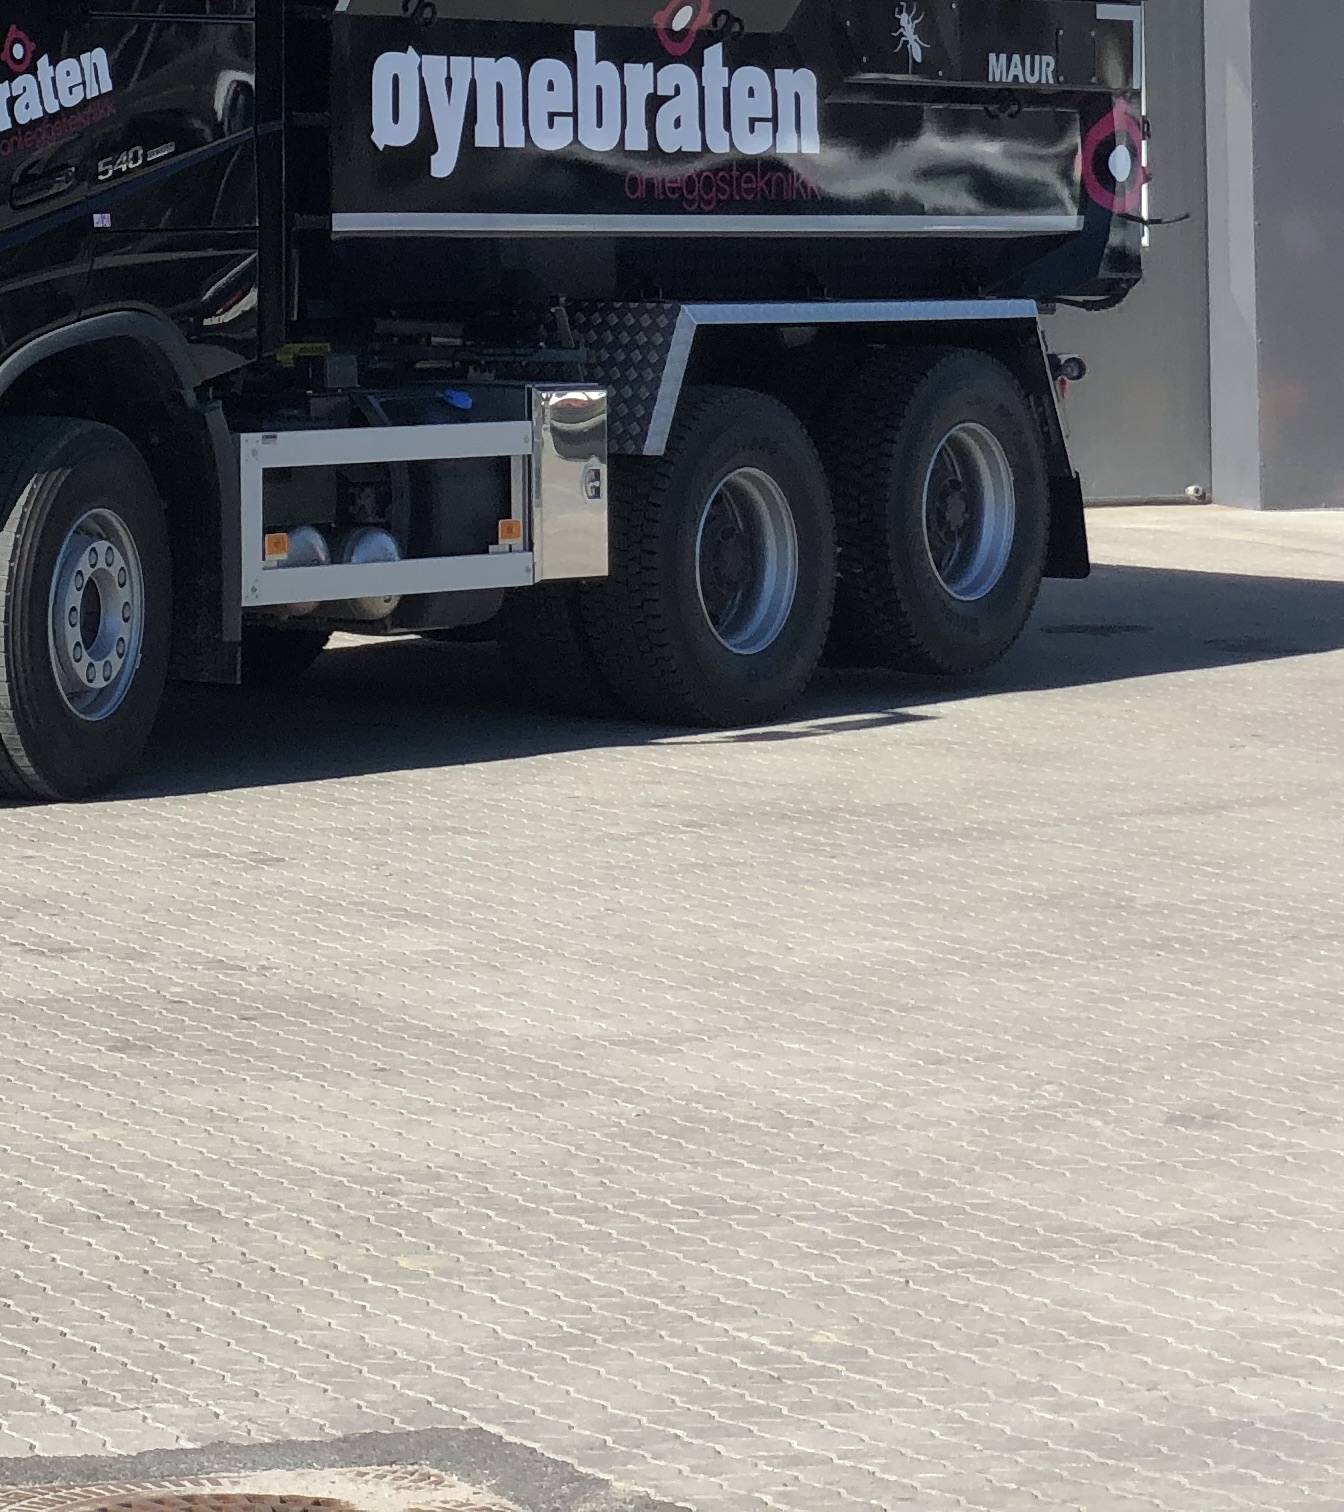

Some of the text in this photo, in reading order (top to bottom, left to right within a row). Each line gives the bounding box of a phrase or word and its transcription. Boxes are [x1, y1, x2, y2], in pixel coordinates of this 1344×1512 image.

[987, 52, 1056, 85] MAUR
[97, 145, 144, 181] 540
[624, 158, 823, 212] anleggsteknikk
